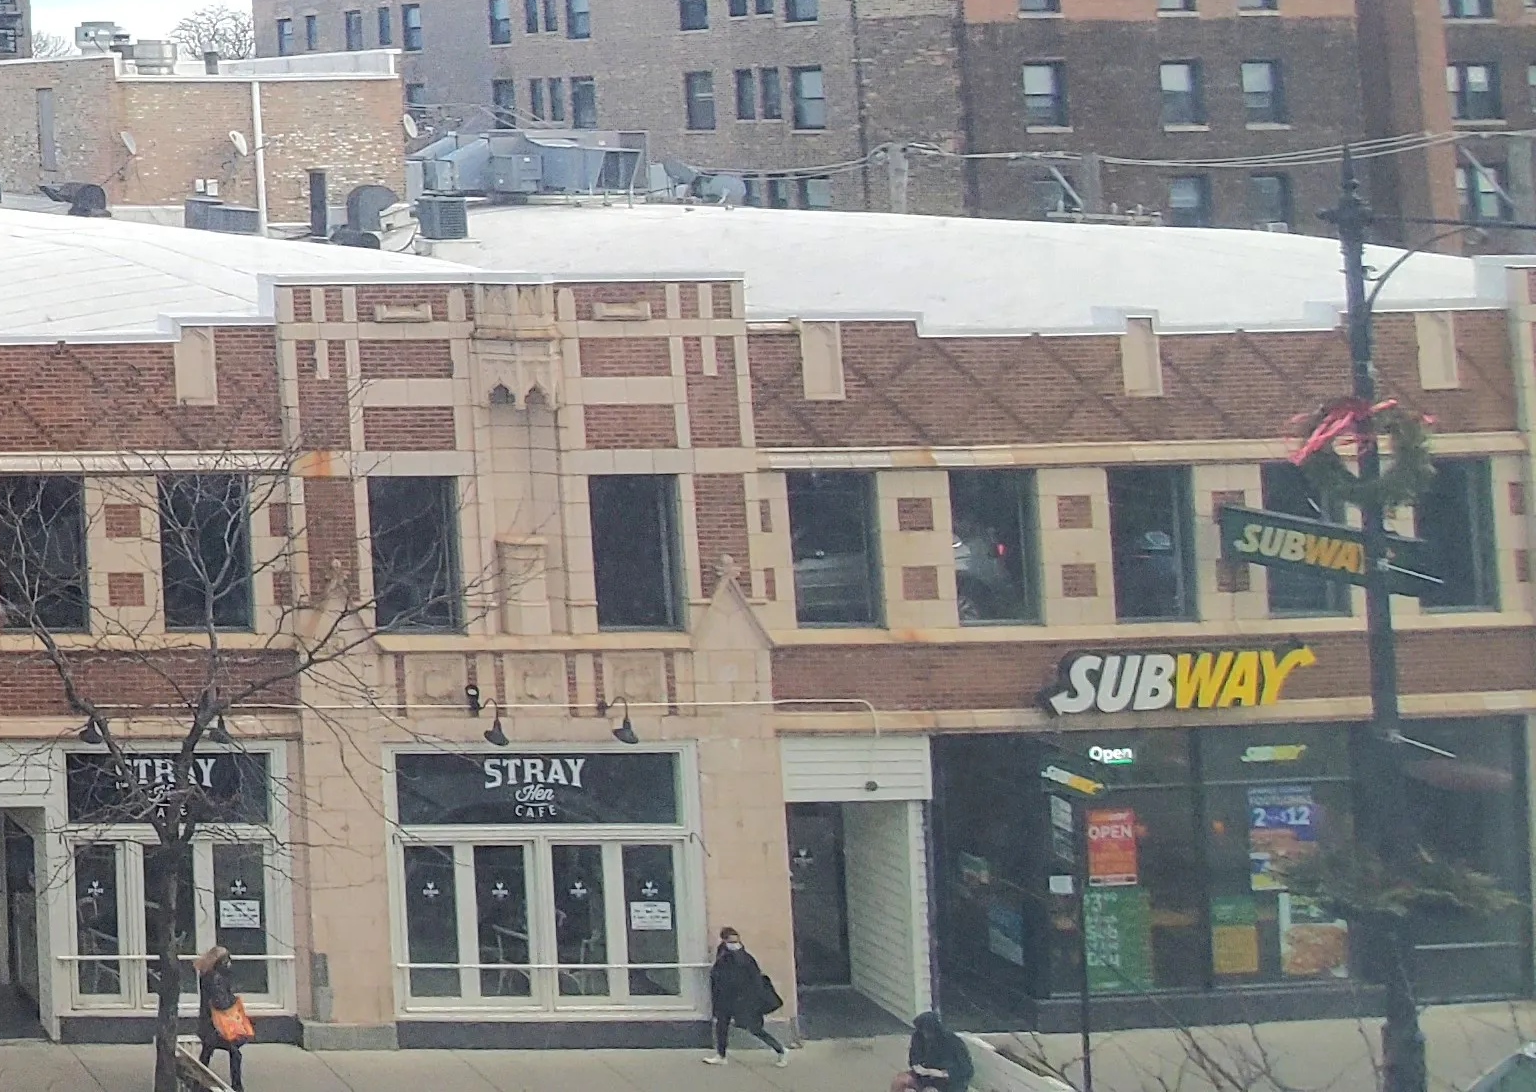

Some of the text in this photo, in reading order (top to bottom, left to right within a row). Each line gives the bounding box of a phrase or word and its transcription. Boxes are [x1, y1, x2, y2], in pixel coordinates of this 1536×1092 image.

[1233, 523, 1365, 575] SUBWA
[1050, 645, 1316, 715] SUBWAY
[1089, 746, 1133, 763] Open
[484, 758, 586, 789] STRAY
[515, 784, 555, 802] Hen
[514, 805, 558, 818] CAFE
[1252, 808, 1267, 827] 2
[1087, 825, 1133, 840] OPEN
